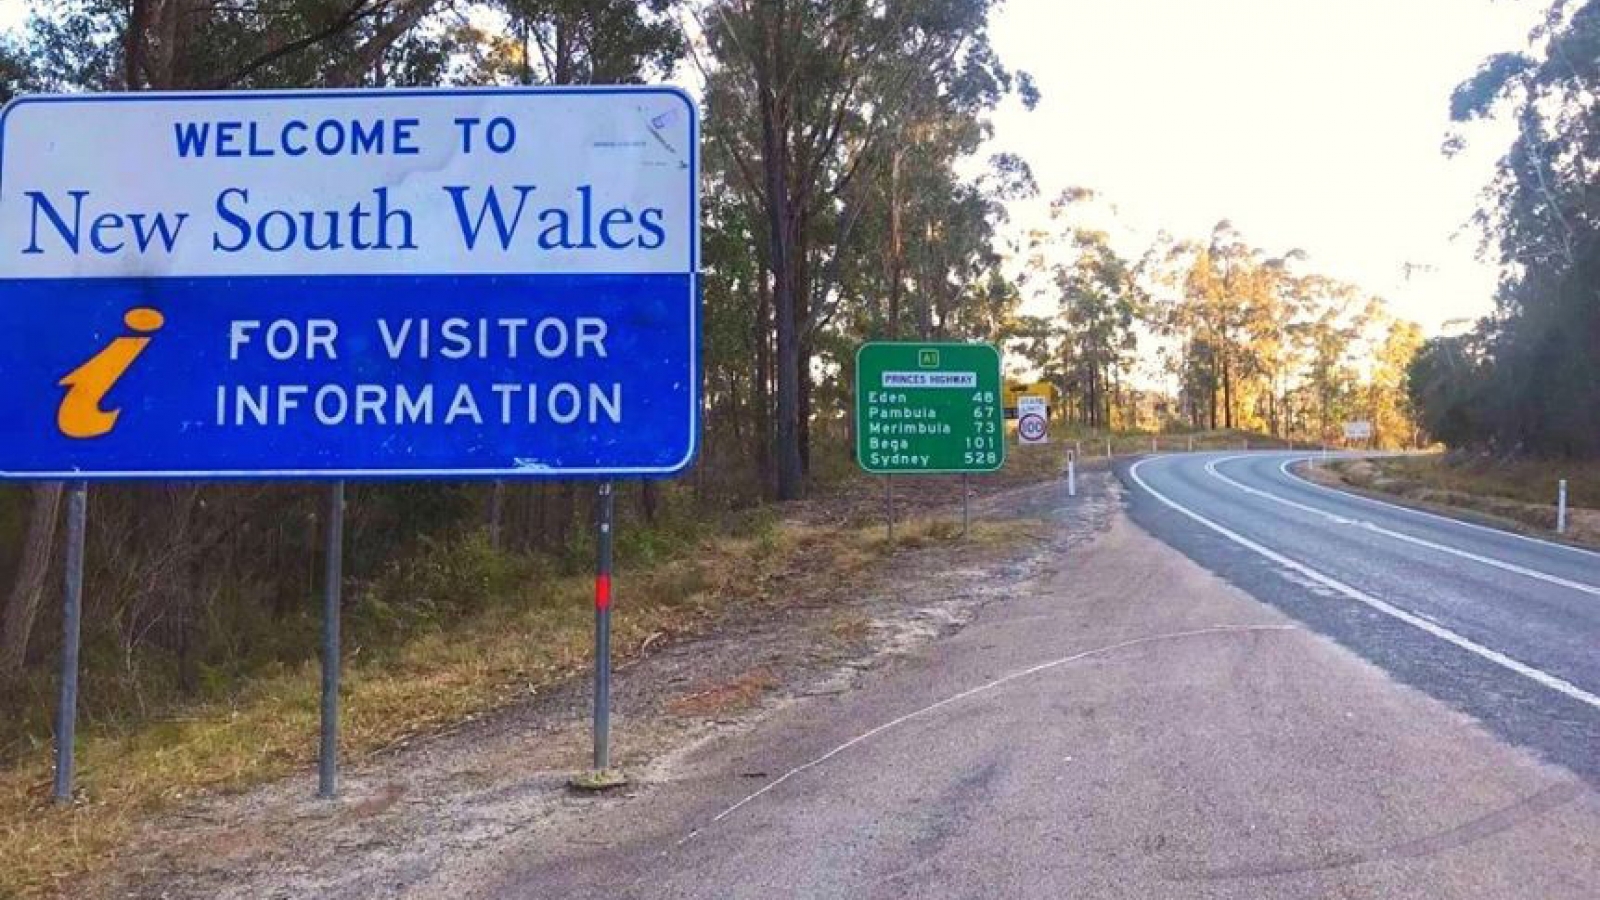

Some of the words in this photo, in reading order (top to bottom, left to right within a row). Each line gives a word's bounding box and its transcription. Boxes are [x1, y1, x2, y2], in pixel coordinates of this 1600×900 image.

[174, 118, 420, 158] WELCOME
[454, 117, 518, 154] TO
[21, 189, 189, 255] New
[212, 187, 418, 252] South
[443, 185, 667, 250] Wales
[229, 319, 339, 361] FOR
[377, 317, 610, 359] VISITOR
[885, 374, 926, 385] PRINCES
[930, 374, 973, 385] HIGHWAY
[216, 383, 623, 426] INFORMATION
[868, 391, 907, 404] Eden
[868, 407, 937, 419] Pambula
[973, 407, 995, 419] 67
[869, 422, 951, 435] Merimbula
[974, 422, 996, 435] 73
[869, 437, 909, 453] Bega
[965, 437, 995, 449] 101
[870, 453, 930, 467] Sydney
[964, 452, 997, 465] 528
